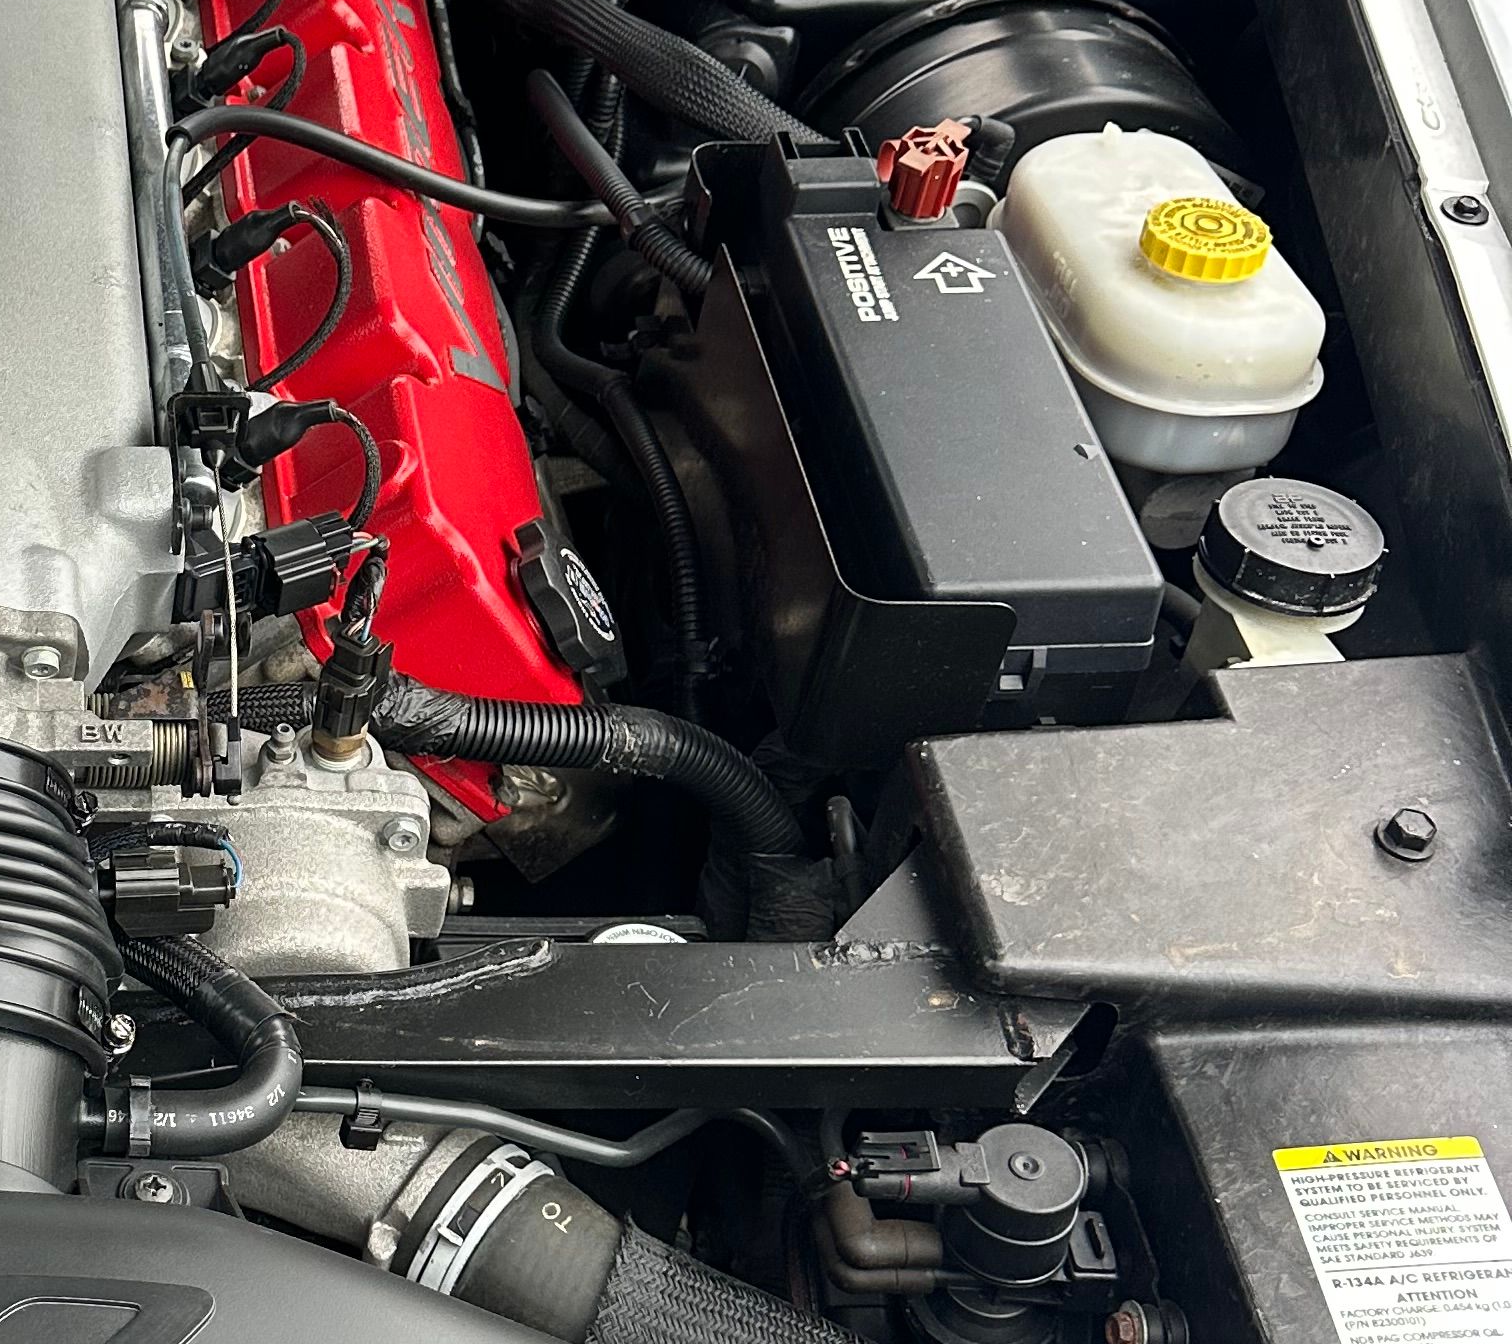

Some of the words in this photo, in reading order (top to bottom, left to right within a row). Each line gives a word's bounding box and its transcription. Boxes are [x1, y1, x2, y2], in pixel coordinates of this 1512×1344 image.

[827, 227, 882, 322] POSITIVE
[79, 723, 124, 744] BW
[266, 1083, 286, 1107] 1/2
[153, 1112, 177, 1128] 1/2
[208, 1105, 255, 1127] 34611
[1342, 1144, 1438, 1162] WARNING
[1290, 1169, 1390, 1185] HIGH-PRESSURE
[1394, 1164, 1480, 1178] REFRIGERANT
[1295, 1183, 1343, 1196] SYSTEM
[1346, 1182, 1363, 1193] TO
[1367, 1181, 1383, 1191] BE
[1386, 1177, 1450, 1190] SERVICED
[1453, 1176, 1469, 1186] BY
[1299, 1194, 1367, 1207] QUALIFIED
[1371, 1189, 1448, 1203] PERSONNEL
[1450, 1187, 1488, 1198] ONLY.
[1304, 1210, 1357, 1223] CONSULT
[1359, 1207, 1406, 1218] SERVICE
[1308, 1220, 1366, 1233] IMPROPER
[1369, 1217, 1416, 1228] SERVICE
[1418, 1214, 1472, 1225] METHODS
[1474, 1211, 1501, 1221] MAY
[1312, 1232, 1350, 1243] CAUSE
[1353, 1229, 1412, 1241] PERSONAL
[1459, 1223, 1501, 1234] SYSTEM
[1316, 1243, 1351, 1254] MEETS
[1354, 1240, 1393, 1251] SAFETY
[1396, 1235, 1481, 1248] REQUIREMENTS
[1483, 1234, 1498, 1244] OF
[1320, 1254, 1342, 1264] SAE
[1344, 1250, 1405, 1263] STANDARD
[1332, 1276, 1385, 1289] R-134A
[1389, 1273, 1419, 1286] A/C
[1422, 1268, 1512, 1283] REFRIGERAN
[1397, 1288, 1478, 1303] ATTENTION
[1340, 1307, 1389, 1319] FACTORY
[1344, 1319, 1369, 1331] (P/N
[1377, 1334, 1400, 1343] PAG
[1403, 1329, 1480, 1342] COMPRESSOR
